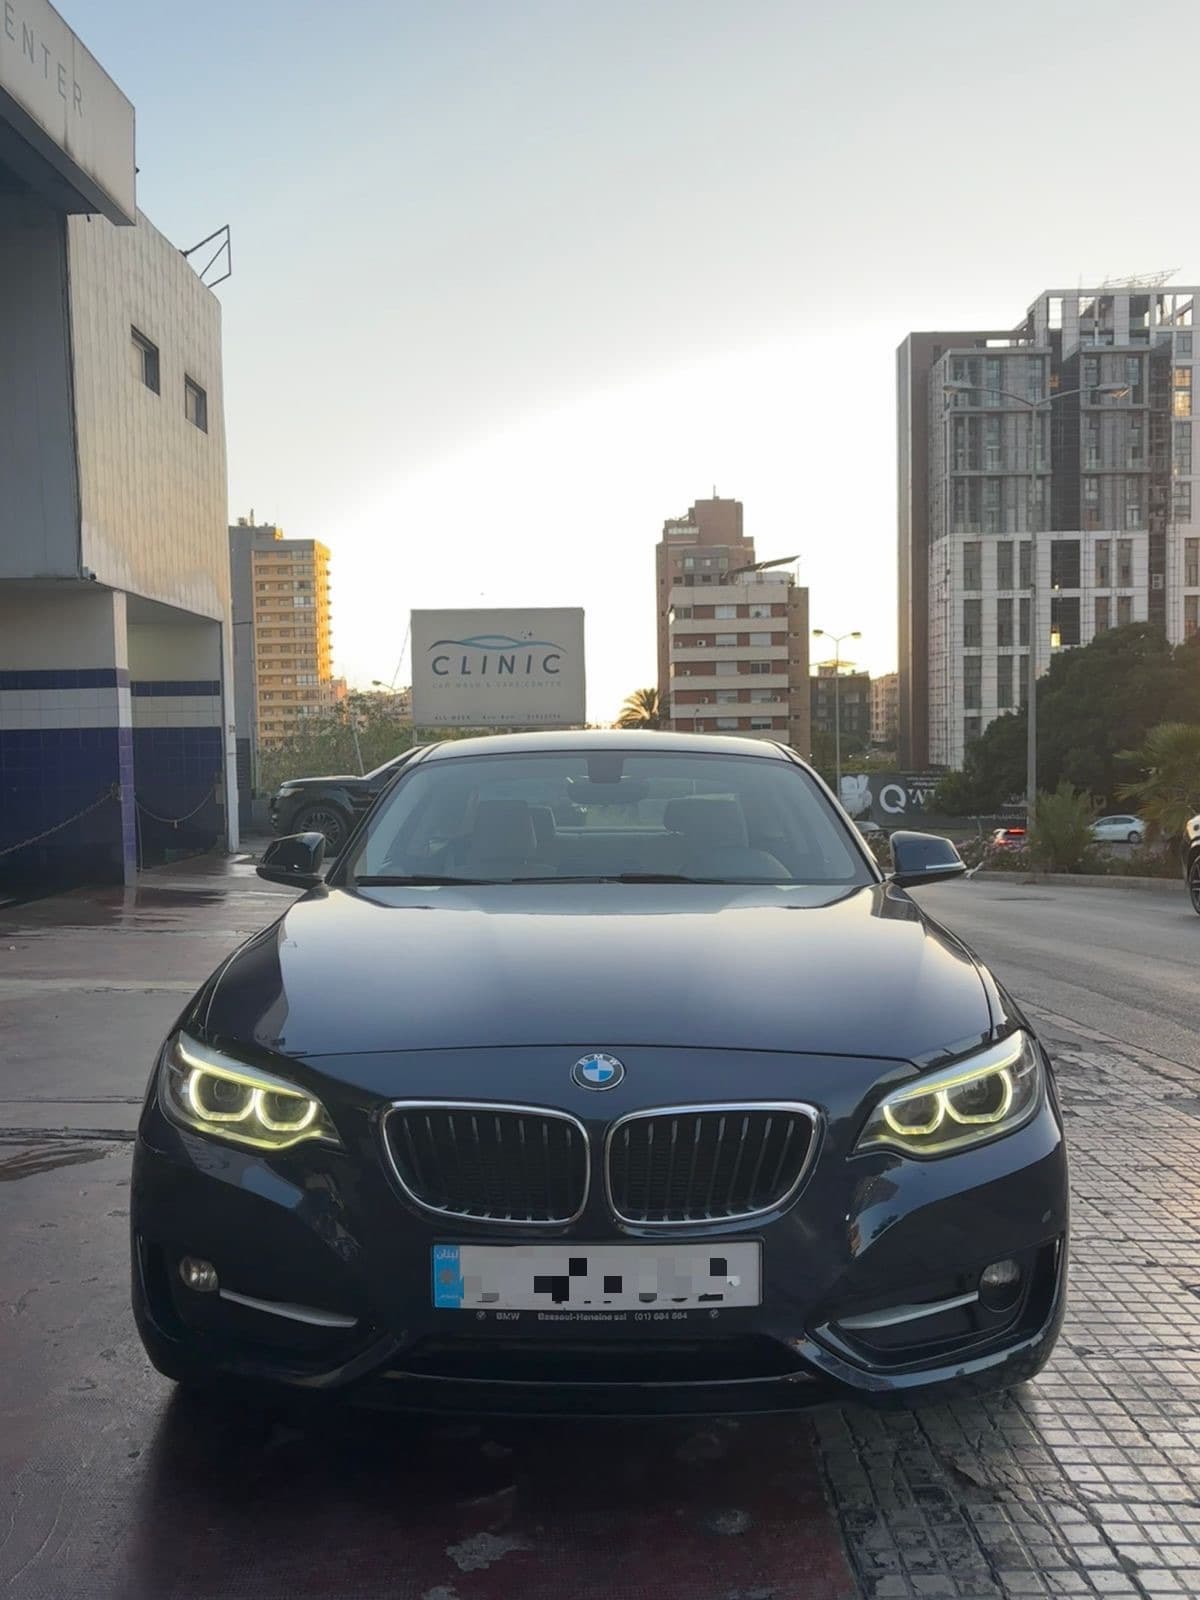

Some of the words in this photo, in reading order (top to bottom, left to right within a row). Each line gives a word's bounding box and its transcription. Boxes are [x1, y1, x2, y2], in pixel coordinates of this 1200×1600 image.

[431, 654, 561, 676] CLINIC
[578, 1054, 620, 1066] BMW
[496, 1312, 520, 1321] BMW
[634, 1312, 652, 1321] (01)
